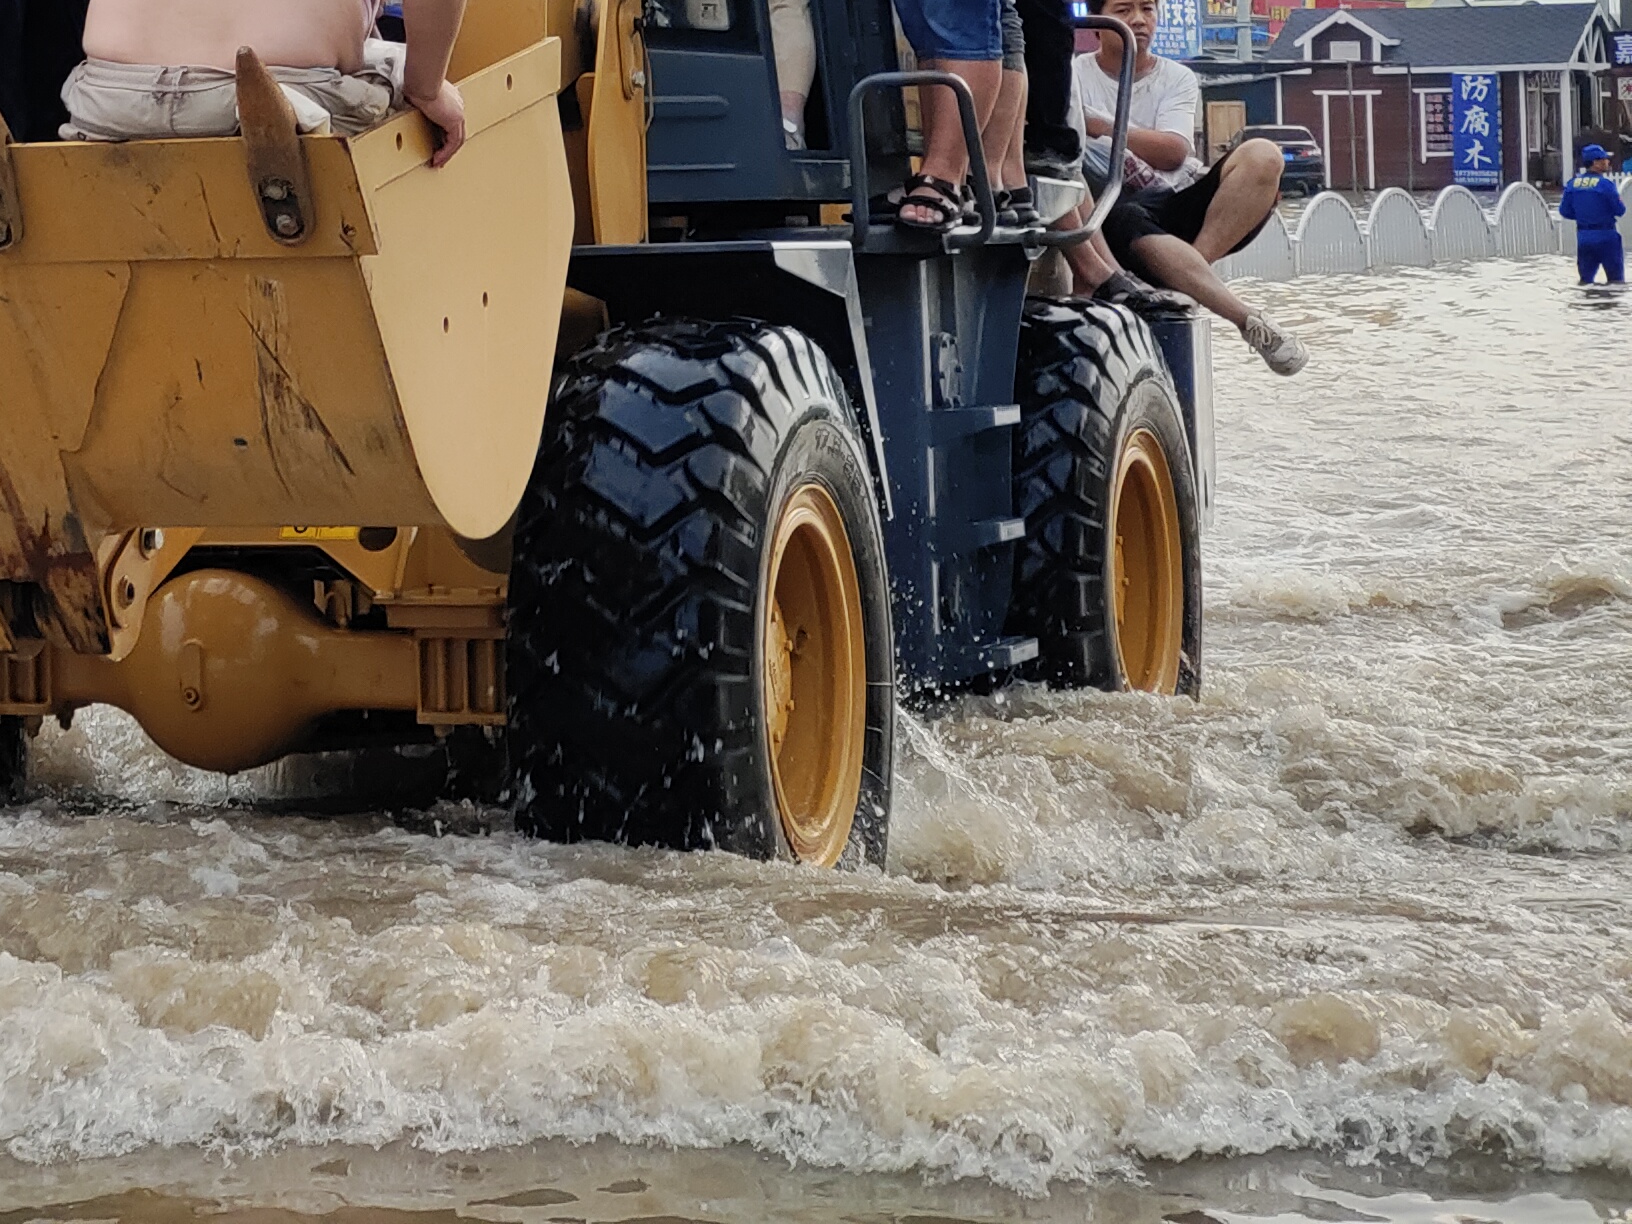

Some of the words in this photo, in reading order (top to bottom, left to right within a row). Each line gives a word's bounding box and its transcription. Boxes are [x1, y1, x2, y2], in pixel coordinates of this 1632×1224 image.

[1460, 75, 1493, 170] 防腐木
[1572, 176, 1600, 189] BSR
